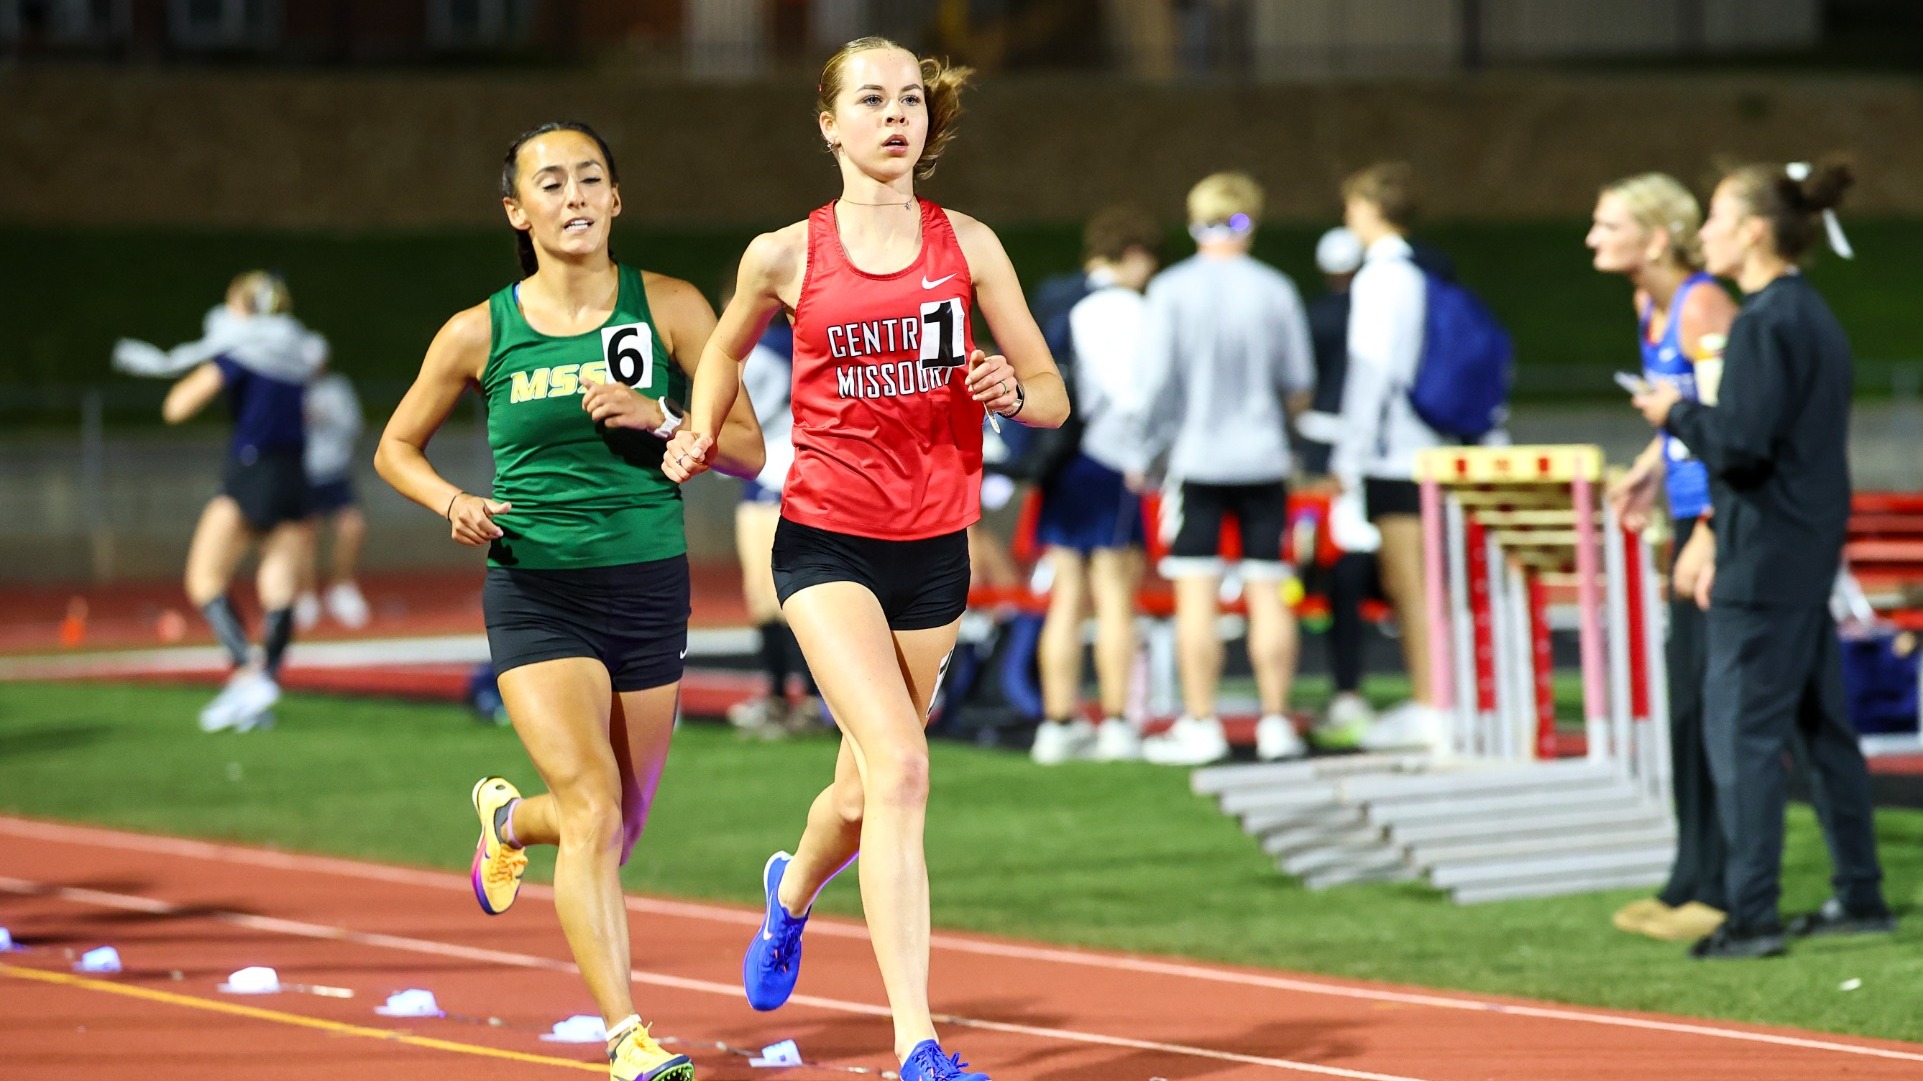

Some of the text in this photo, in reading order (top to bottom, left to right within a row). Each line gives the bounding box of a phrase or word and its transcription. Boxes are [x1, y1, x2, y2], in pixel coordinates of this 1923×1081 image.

[607, 327, 644, 387] 6
[827, 316, 919, 359] CENTR
[923, 301, 965, 369] 1
[510, 360, 607, 404] MSS
